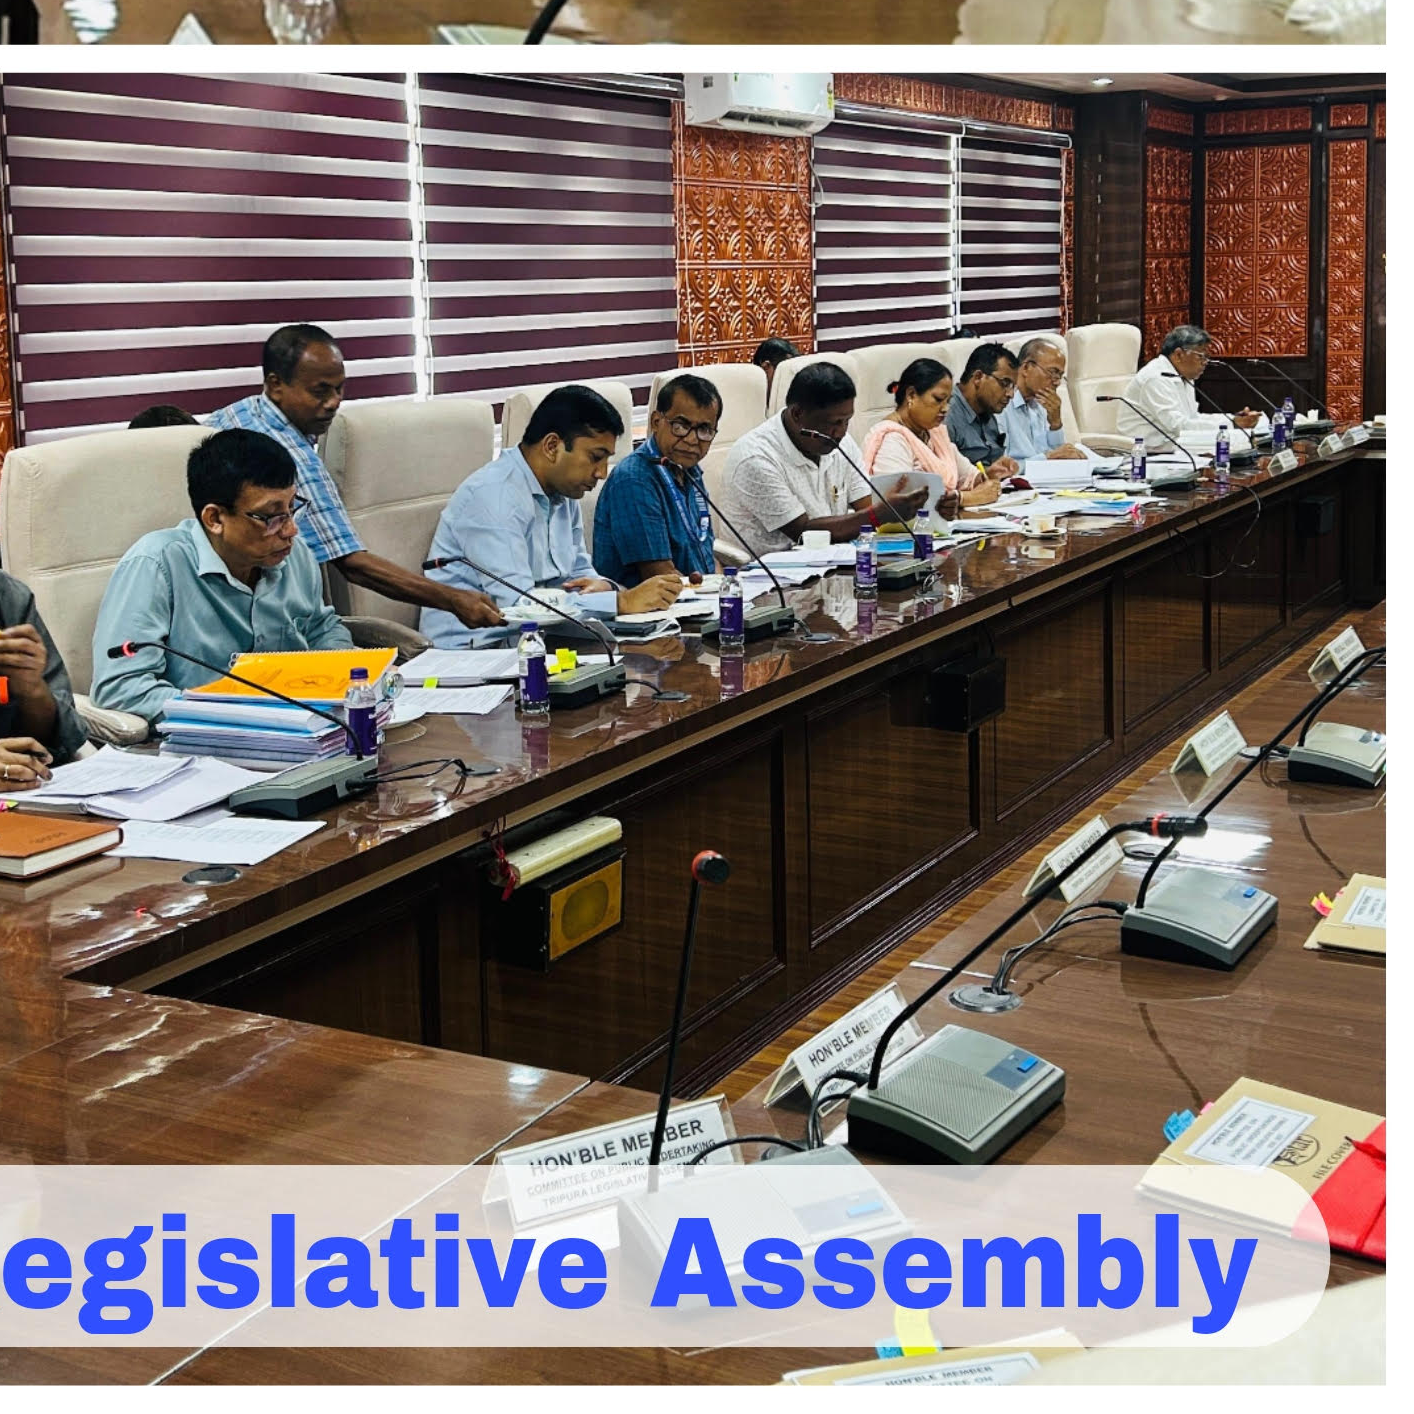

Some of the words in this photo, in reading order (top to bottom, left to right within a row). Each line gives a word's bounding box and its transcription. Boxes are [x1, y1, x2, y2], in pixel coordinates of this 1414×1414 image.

[808, 1030, 854, 1069] HON'BLE
[527, 1171, 588, 1198] COMMITTEE
[591, 1167, 606, 1180] ON
[607, 1156, 645, 1178] PUBLIC
[529, 1140, 617, 1178] HON'BLE
[542, 1189, 589, 1208] TRIPURA
[942, 1365, 994, 1379] MEMBER
